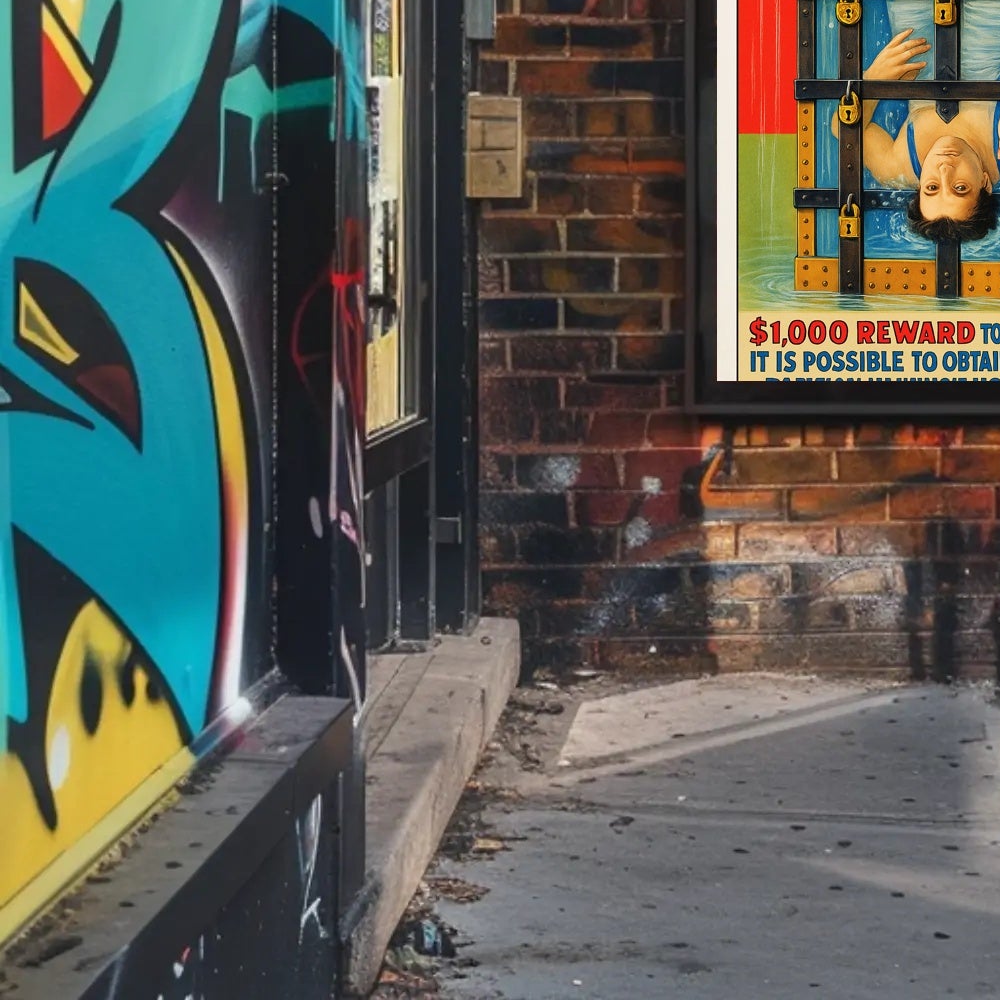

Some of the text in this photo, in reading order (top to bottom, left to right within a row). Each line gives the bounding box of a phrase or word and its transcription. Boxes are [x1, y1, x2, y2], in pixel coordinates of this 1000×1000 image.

[749, 317, 848, 347] $1,000
[856, 320, 976, 346] REWARD
[750, 350, 770, 373] IT
[776, 350, 797, 373] IS
[803, 350, 905, 373] POSSIBLE
[911, 350, 938, 373] TO
